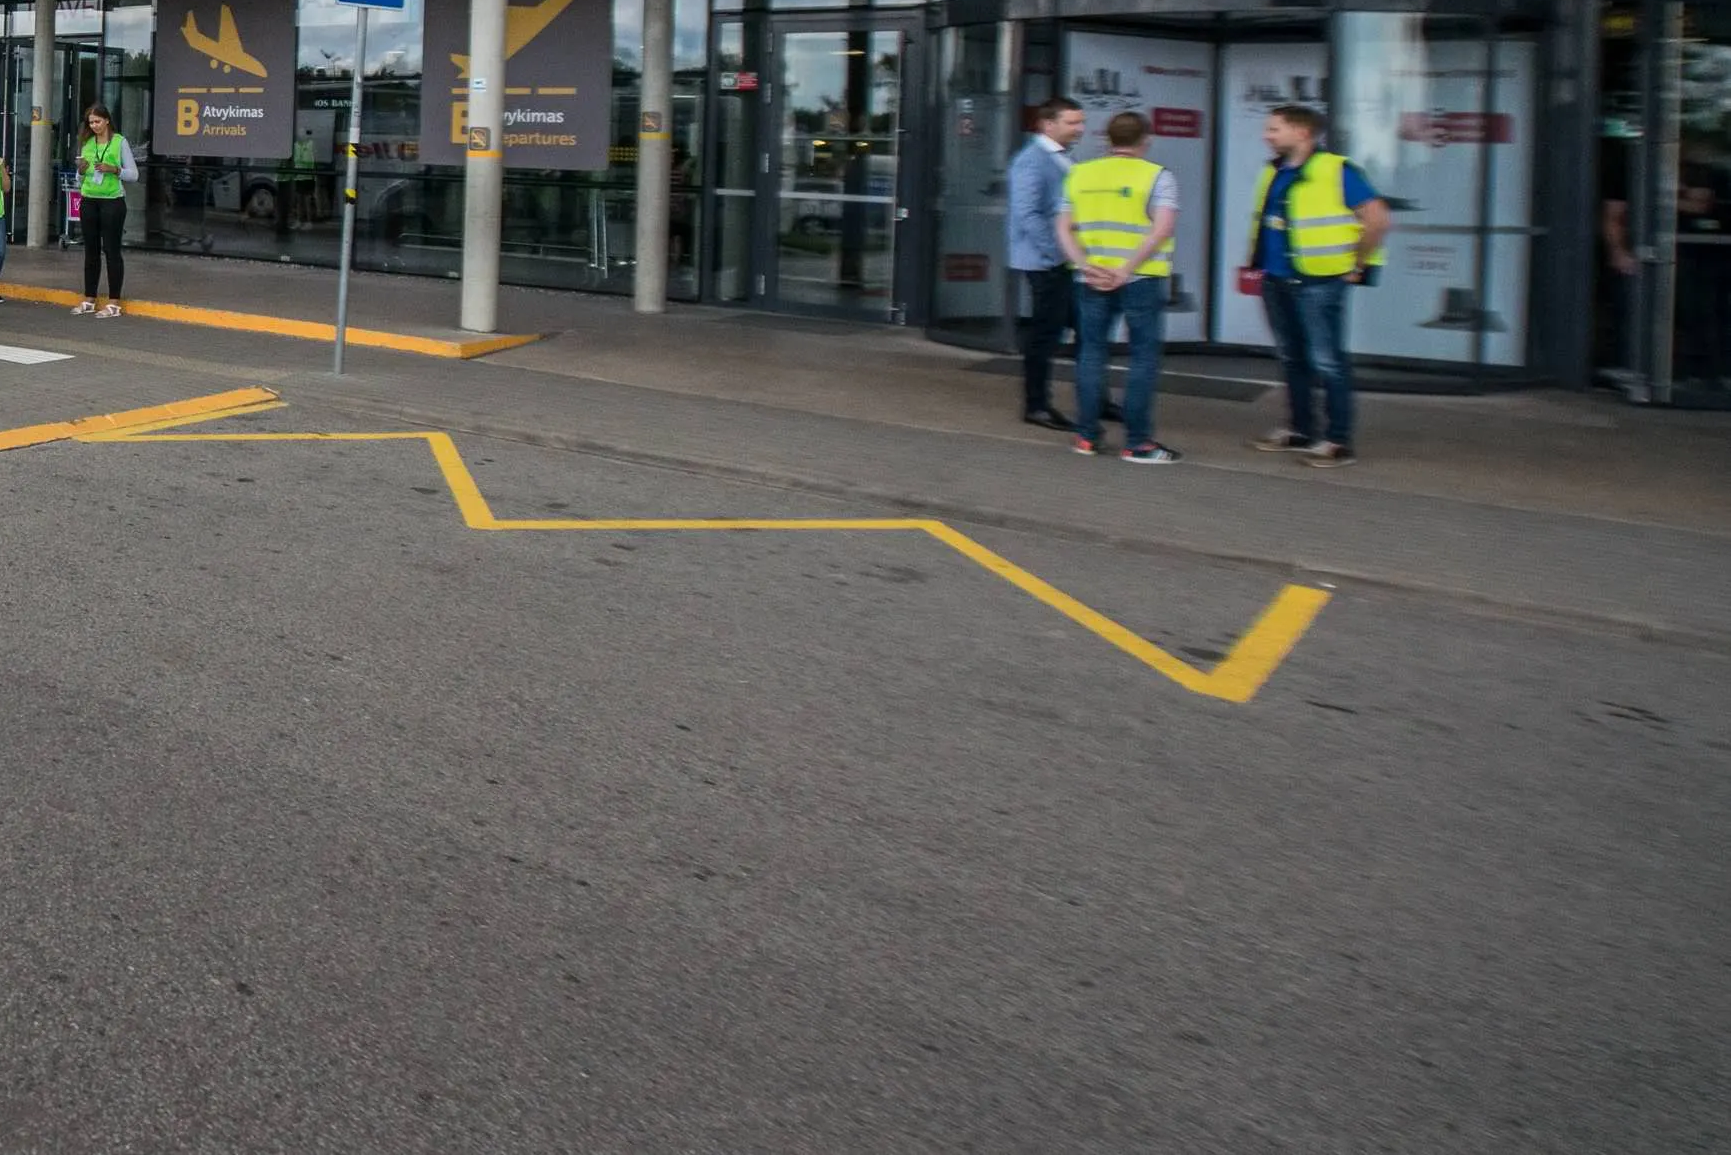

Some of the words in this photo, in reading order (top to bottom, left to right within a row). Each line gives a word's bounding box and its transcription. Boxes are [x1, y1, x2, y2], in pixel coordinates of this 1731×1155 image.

[177, 99, 200, 136] B
[202, 105, 264, 121] Atvykimas
[202, 123, 247, 136] Arrivals
[503, 131, 577, 147] epartures
